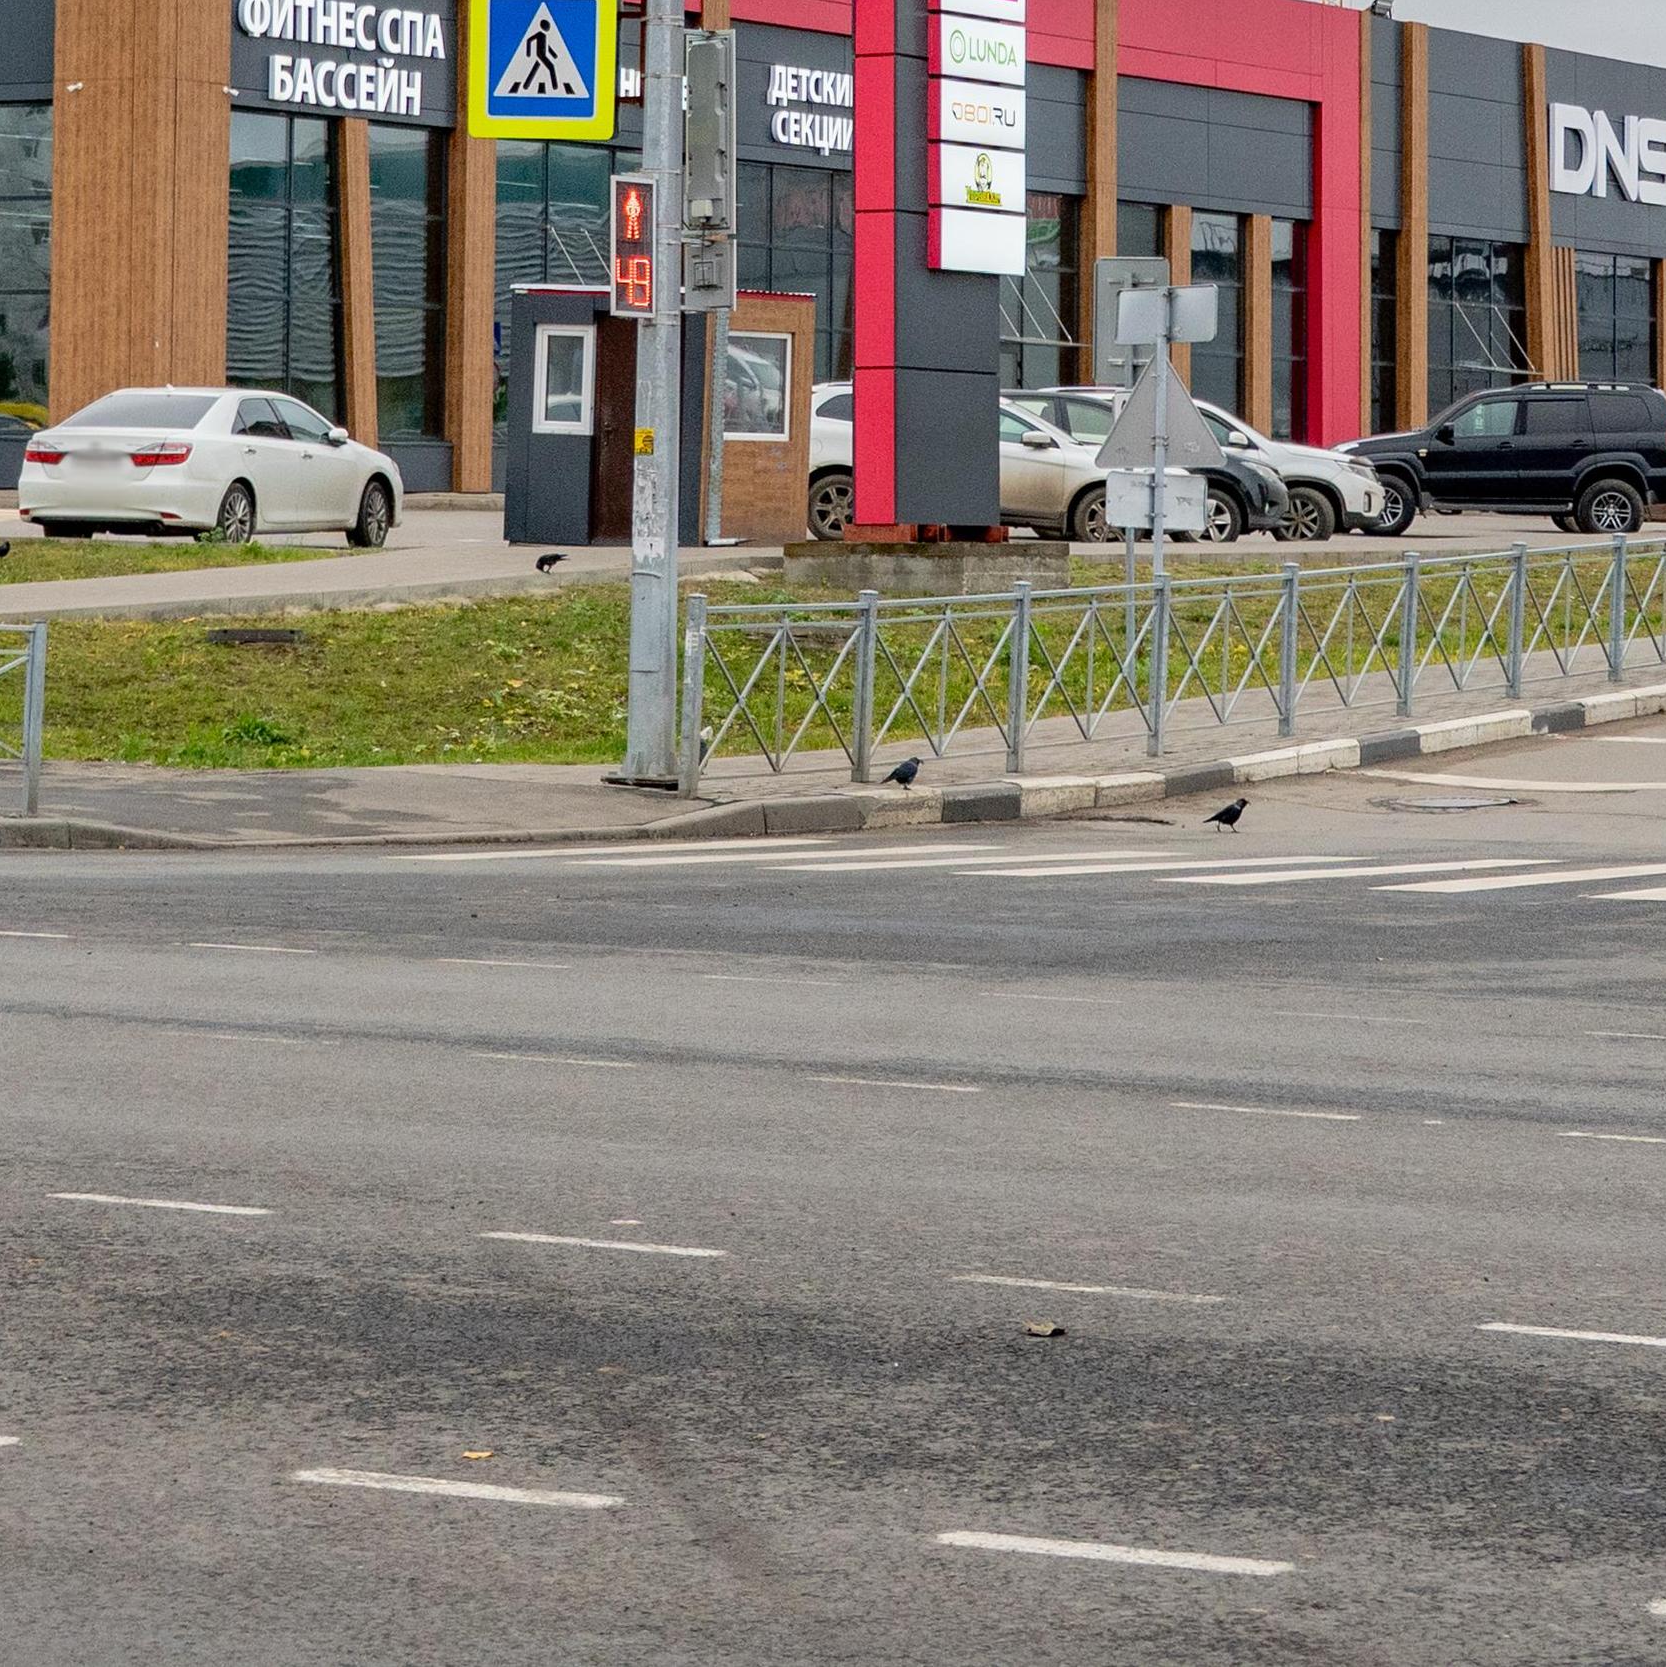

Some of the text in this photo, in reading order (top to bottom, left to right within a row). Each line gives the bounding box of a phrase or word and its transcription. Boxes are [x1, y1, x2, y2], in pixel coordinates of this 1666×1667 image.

[377, 8, 445, 59] СПА
[969, 37, 1017, 67] LUNDA
[268, 54, 422, 116] БАССЕЙН
[766, 64, 853, 108] ДЕТСКИ
[771, 110, 853, 156] СЕКЦИИ
